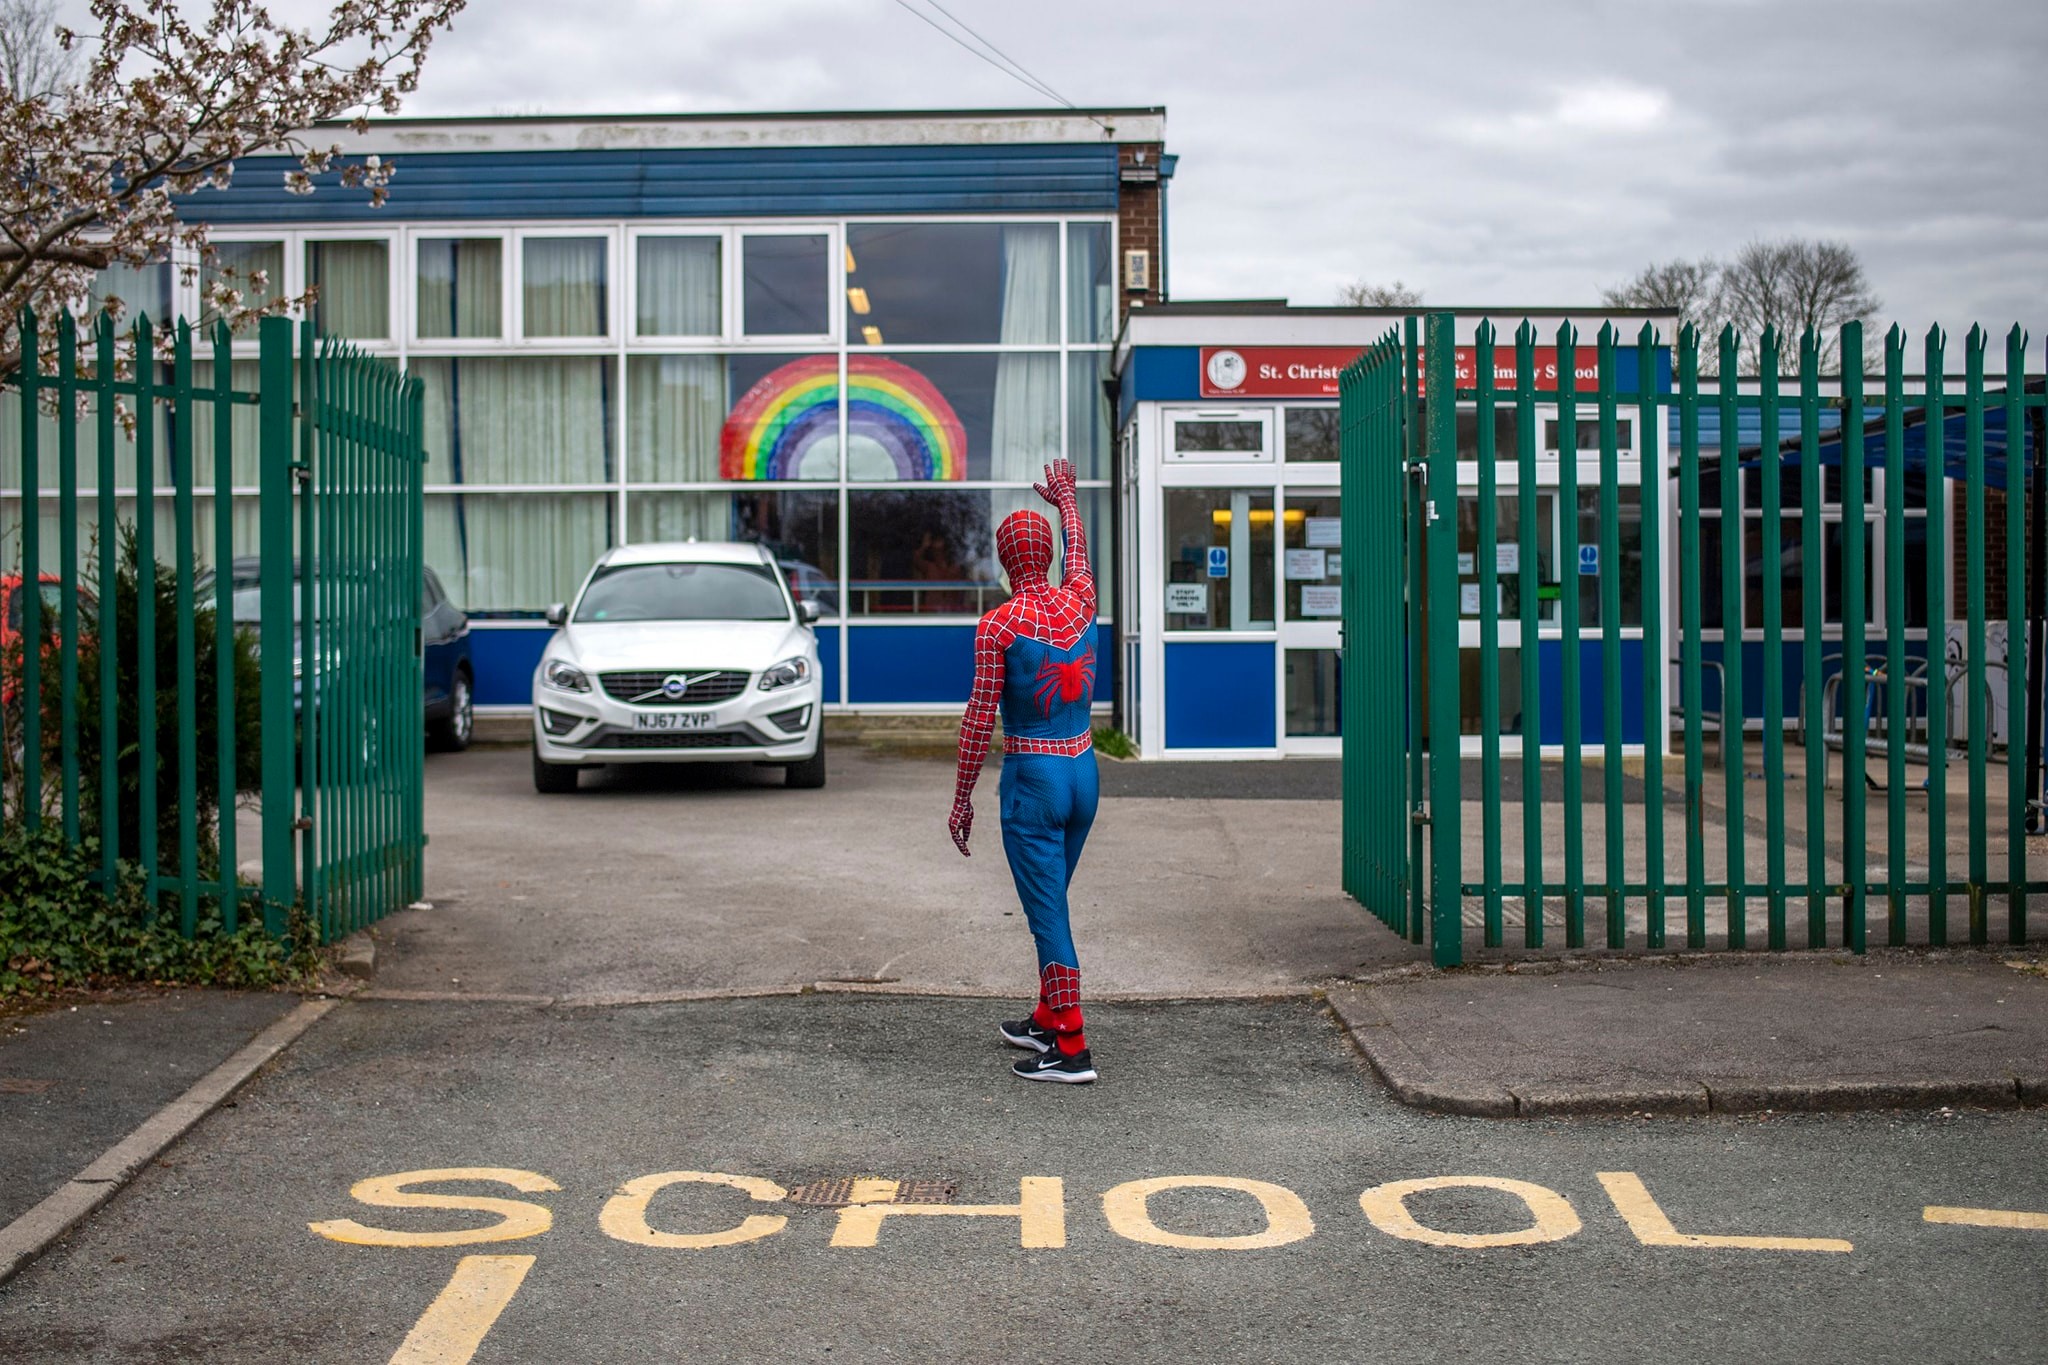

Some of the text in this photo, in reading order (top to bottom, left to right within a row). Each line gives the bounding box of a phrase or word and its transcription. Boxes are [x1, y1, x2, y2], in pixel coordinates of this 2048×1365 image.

[1259, 363, 1283, 379] St.
[1287, 363, 1343, 379] Christ
[1545, 363, 1599, 379] Sool
[637, 713, 711, 729] NJ67 ZVP
[307, 1167, 1854, 1253] SCHOOL
